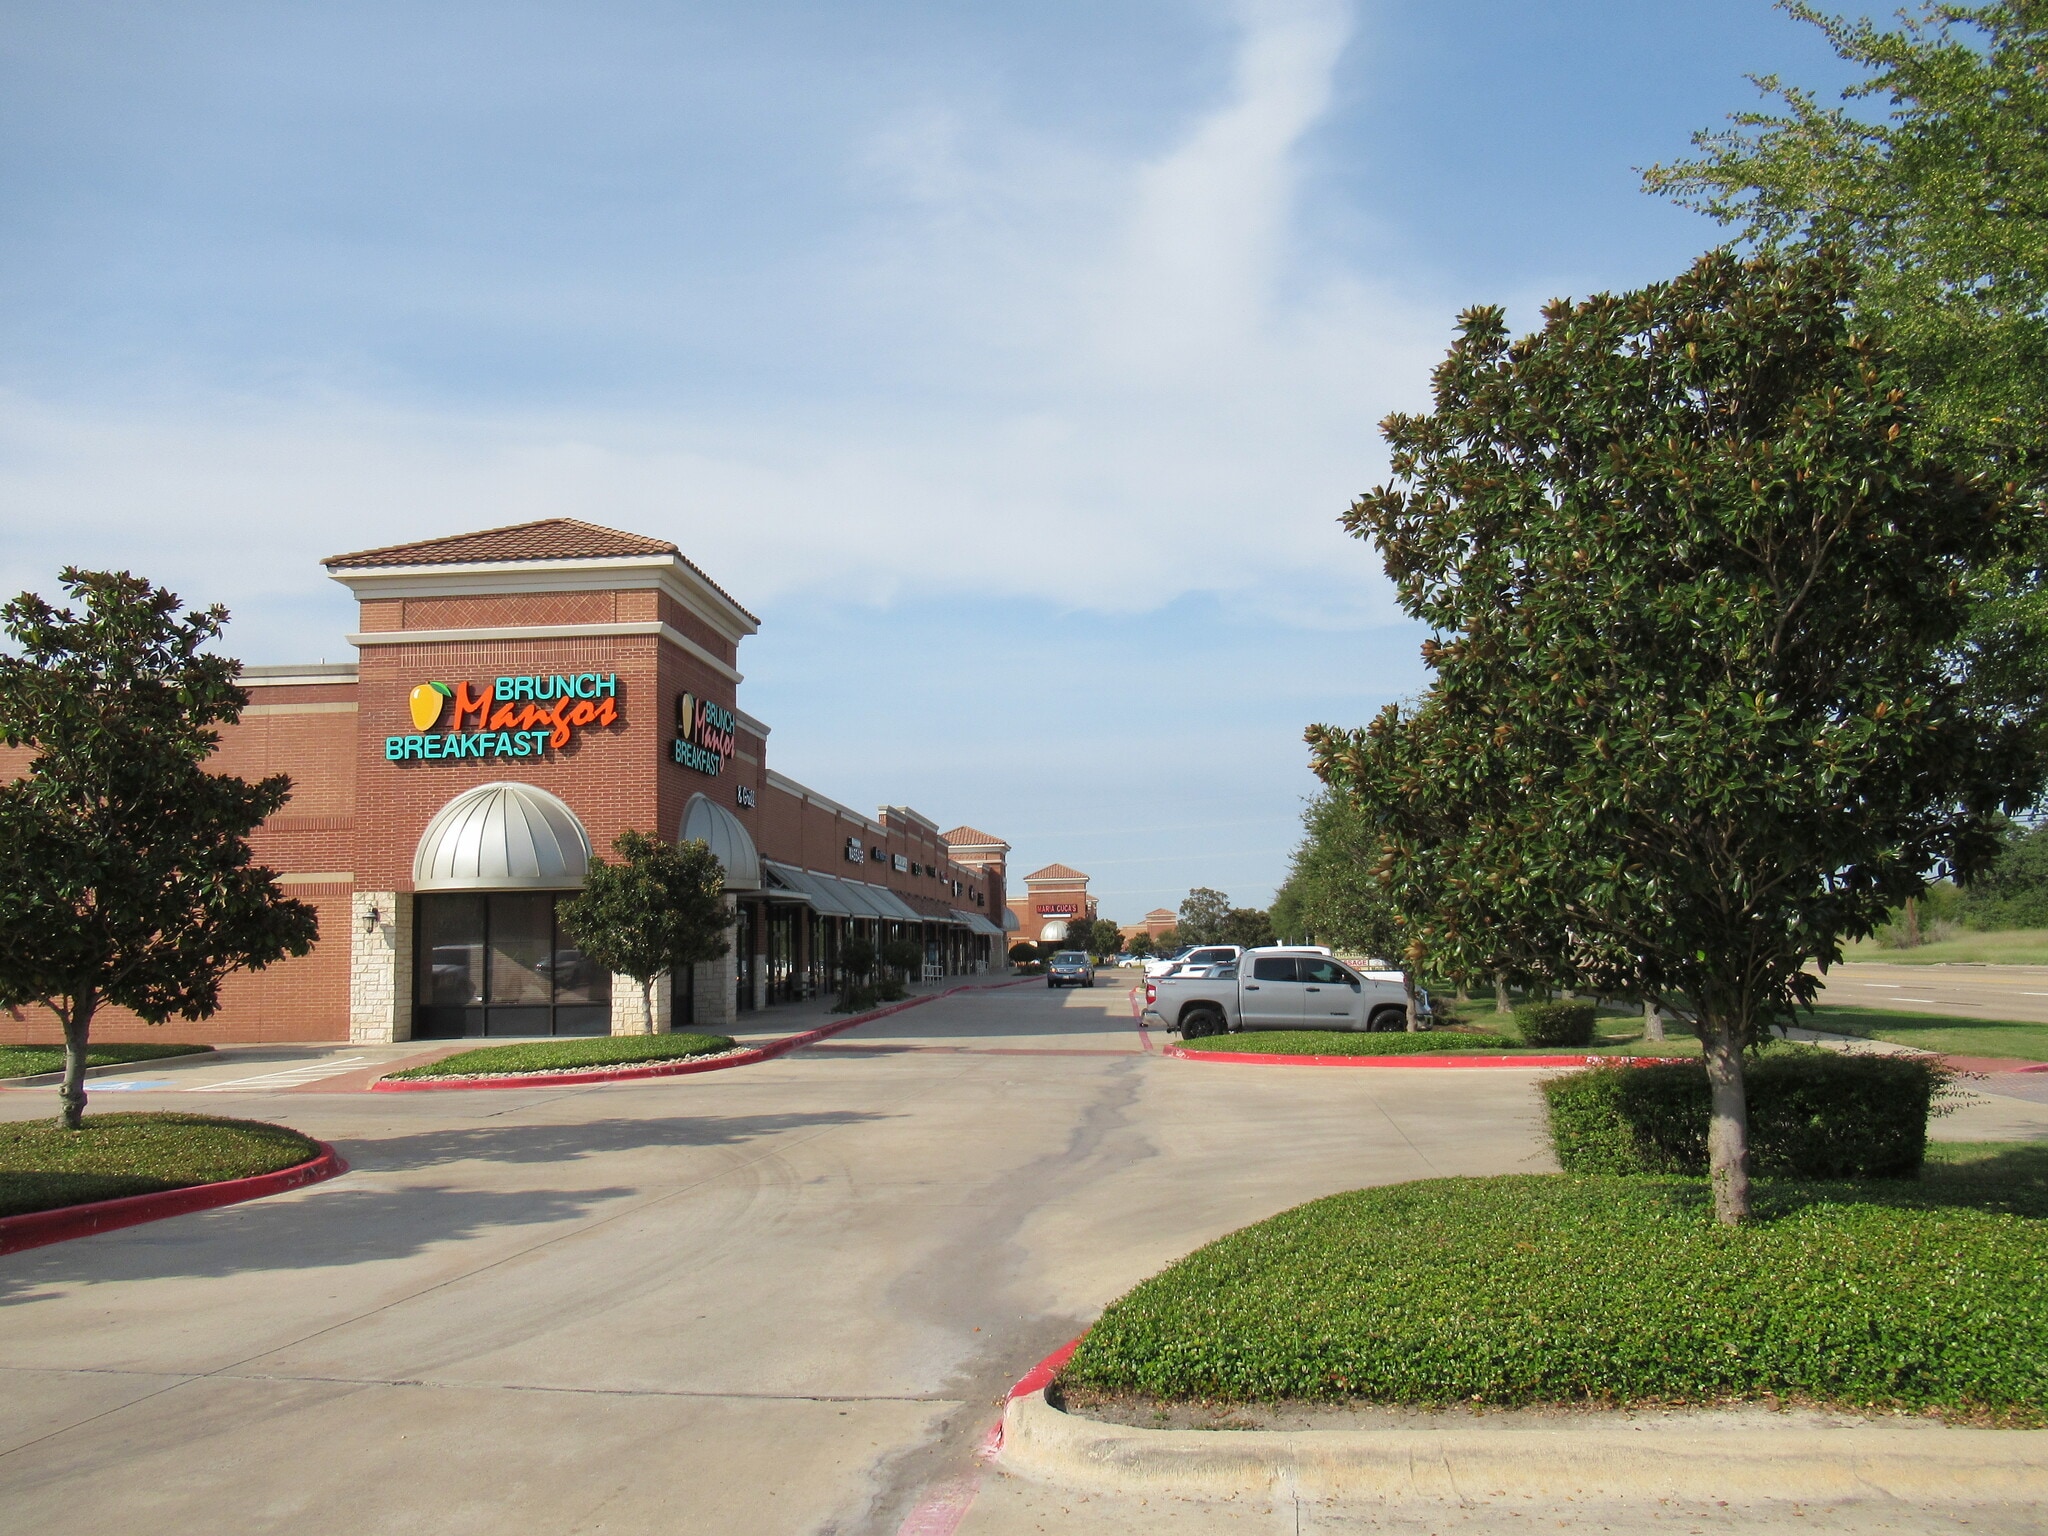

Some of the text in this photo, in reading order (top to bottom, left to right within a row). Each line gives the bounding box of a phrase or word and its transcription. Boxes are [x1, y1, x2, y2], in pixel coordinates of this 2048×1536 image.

[495, 673, 615, 701] BRUNCH
[453, 680, 617, 748] Mangos
[706, 700, 735, 734] BRUNCH
[385, 731, 550, 760] BREAKFAST
[695, 698, 736, 773] Mangos
[675, 739, 720, 776] BREAKFAST
